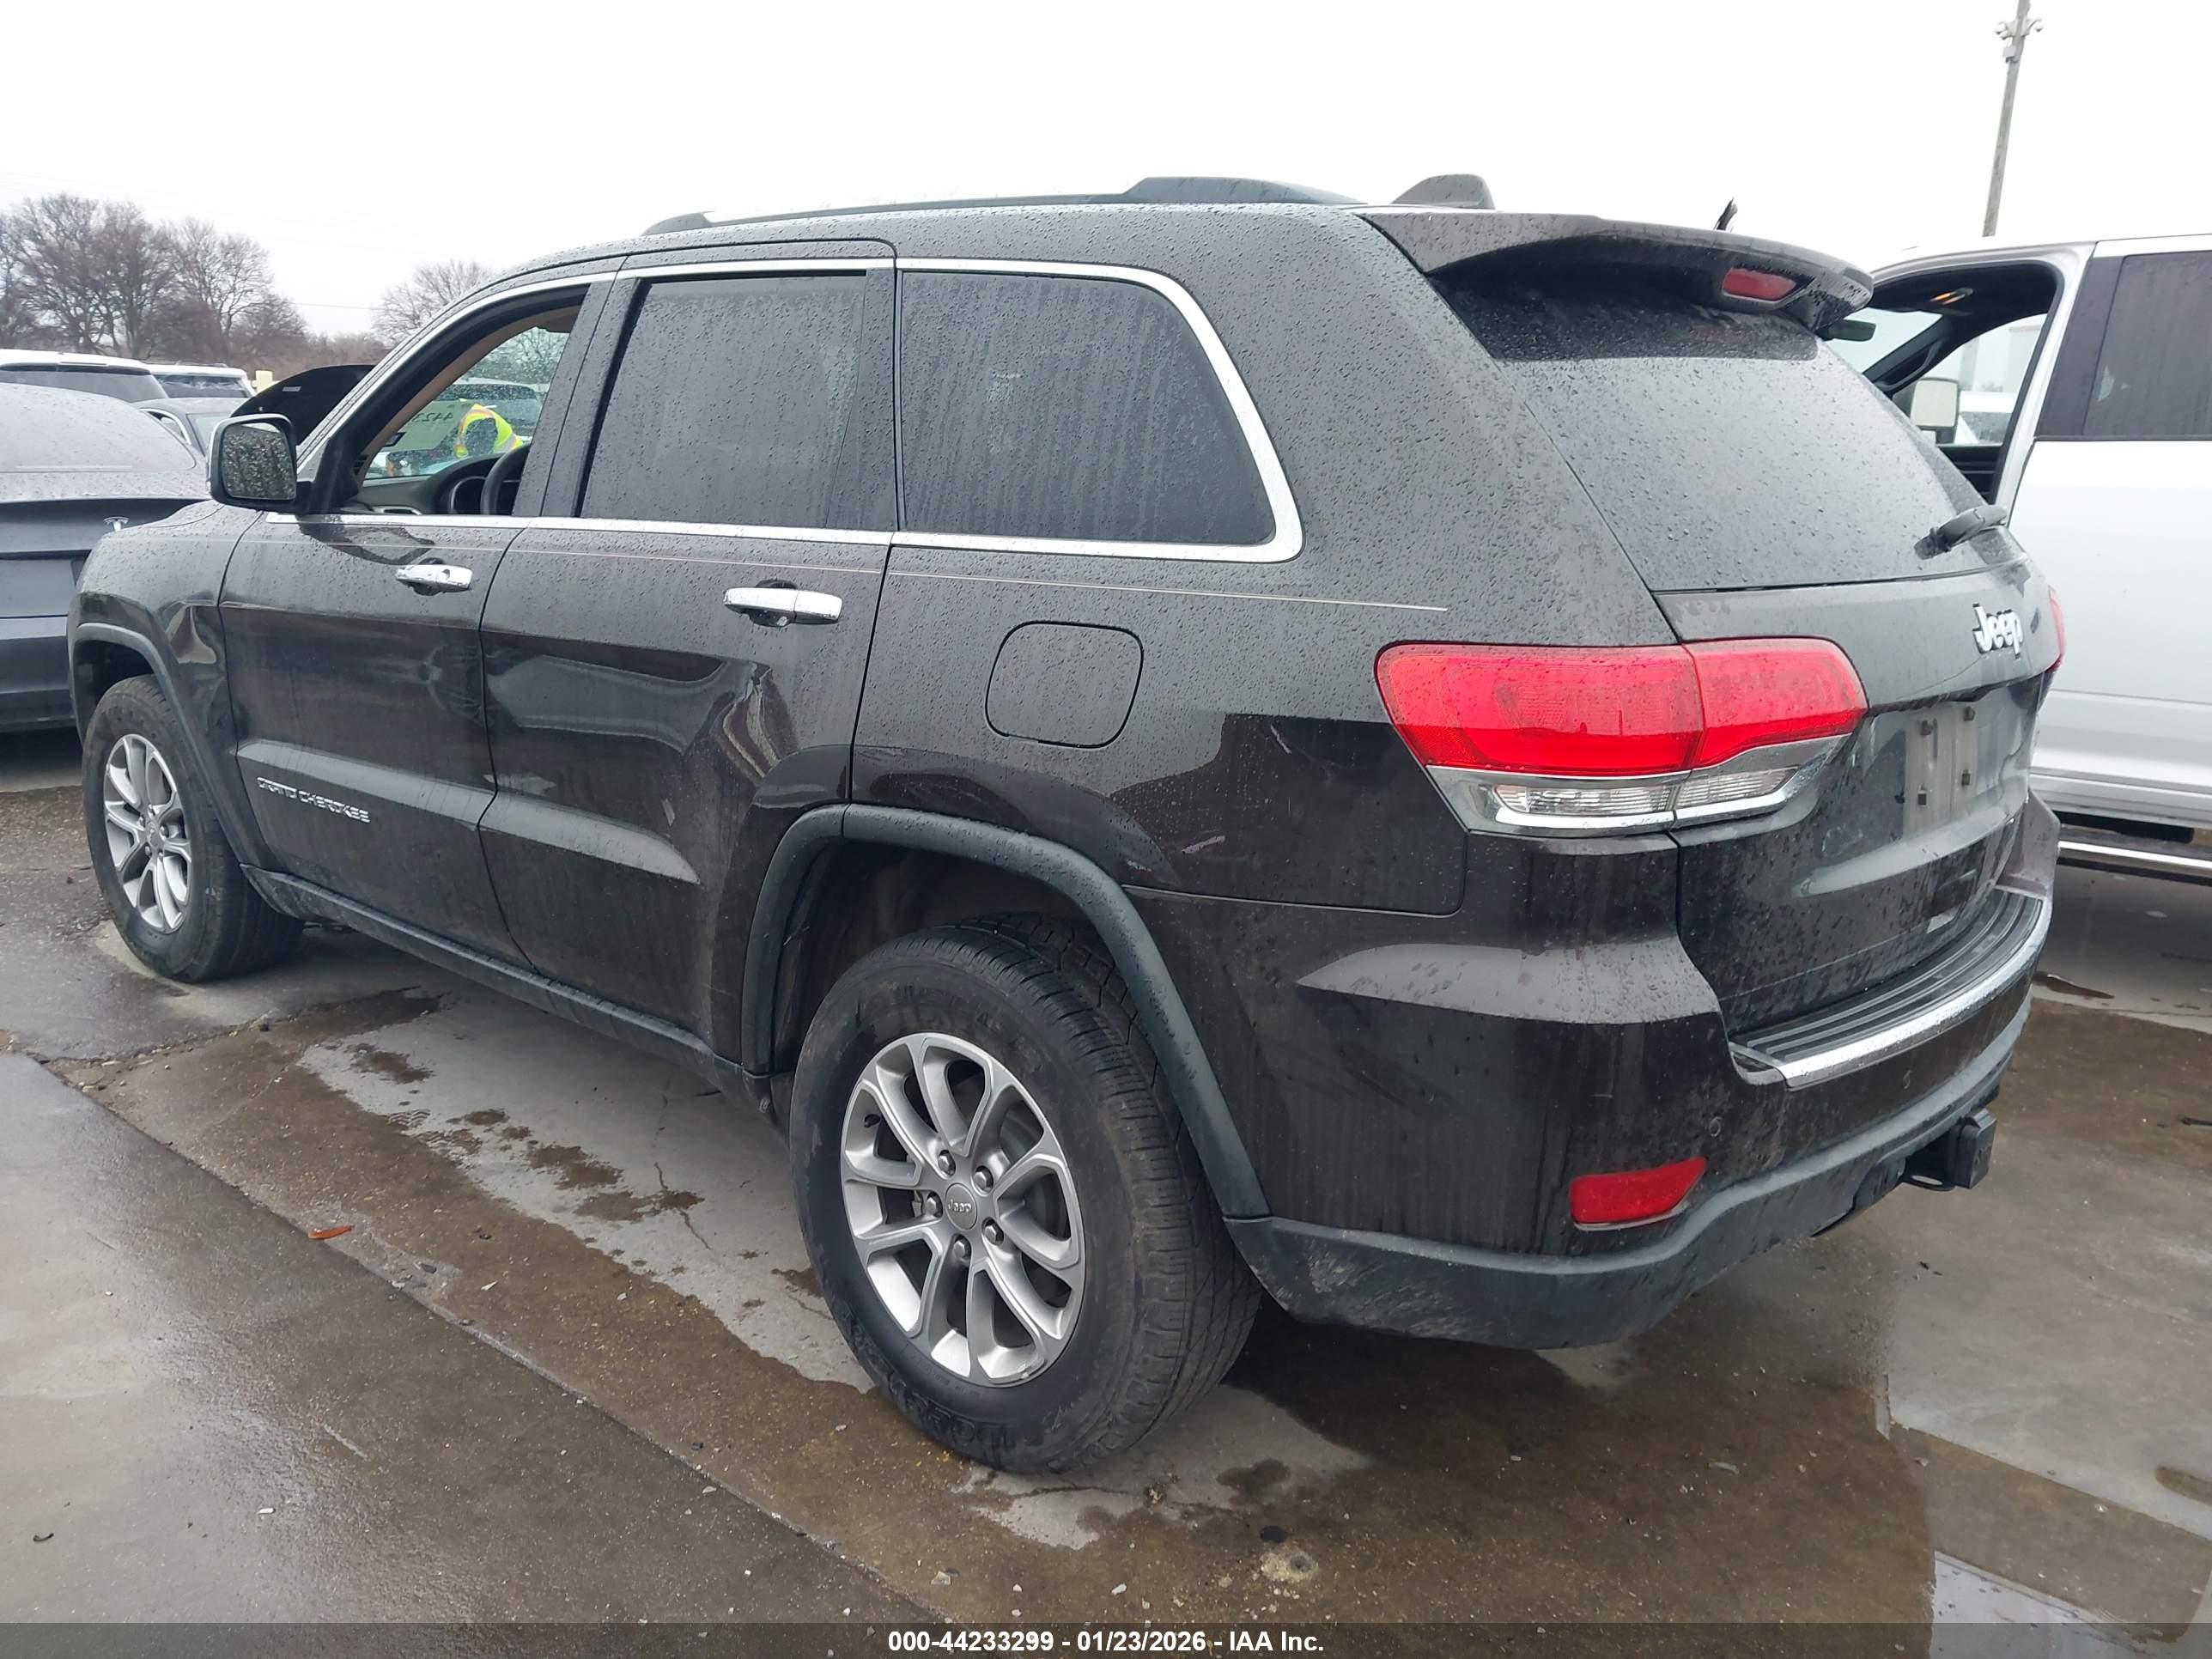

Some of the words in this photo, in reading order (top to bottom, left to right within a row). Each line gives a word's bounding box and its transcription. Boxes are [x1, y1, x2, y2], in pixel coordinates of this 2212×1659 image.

[1972, 603, 2024, 659] Jeep
[298, 790, 371, 823] CHEROKEE
[948, 1198, 972, 1212] Jeep
